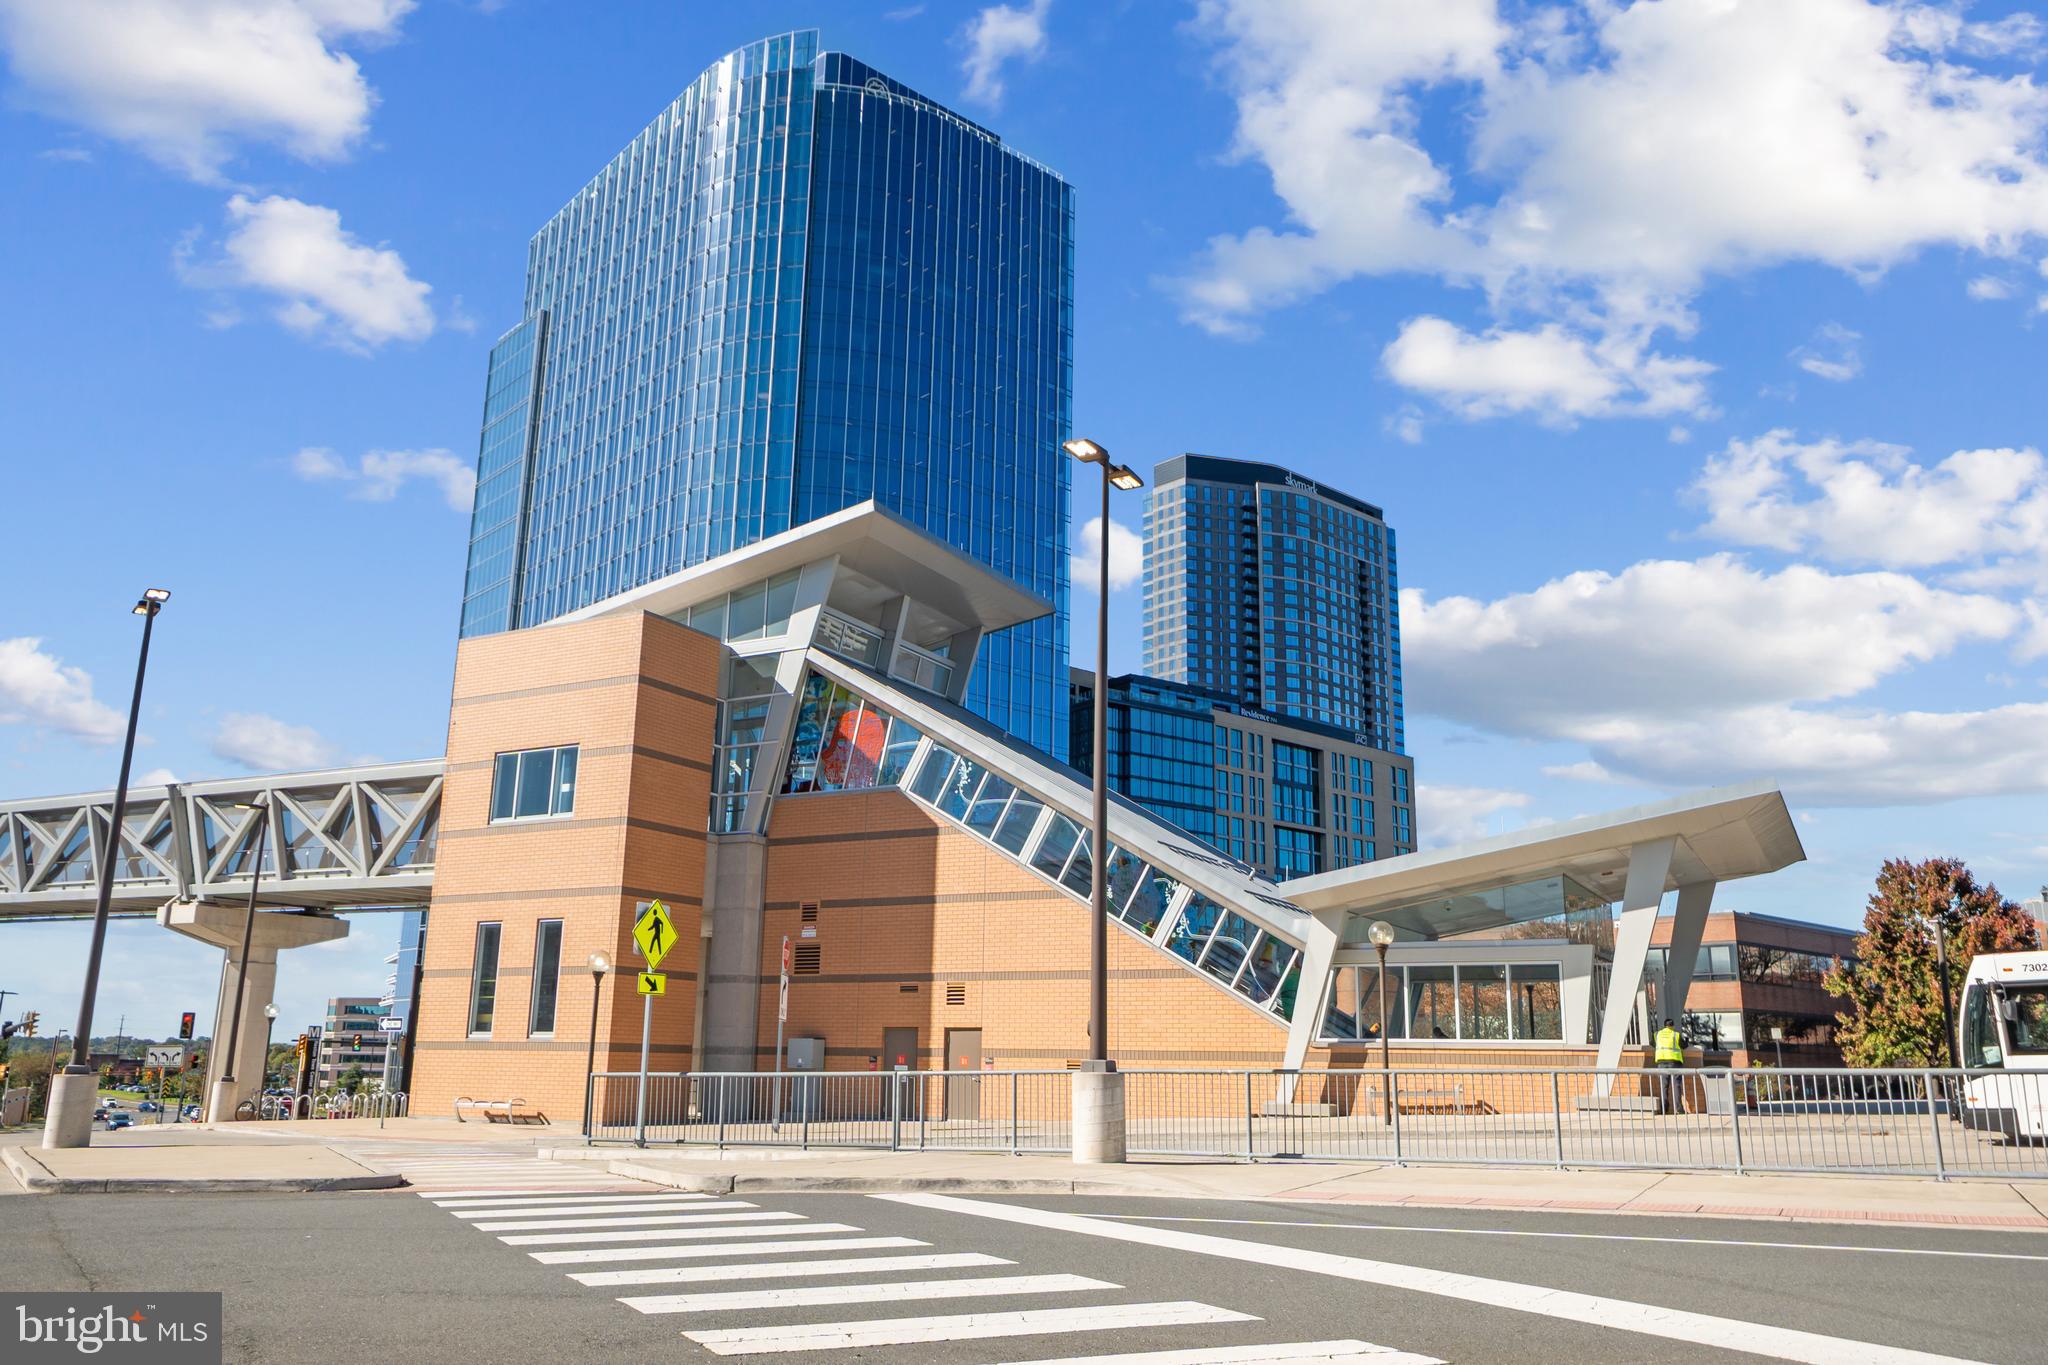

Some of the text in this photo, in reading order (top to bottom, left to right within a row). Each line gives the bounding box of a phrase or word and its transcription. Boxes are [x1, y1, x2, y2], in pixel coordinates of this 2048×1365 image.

[1285, 472, 1317, 494] skymark
[1241, 707, 1269, 722] Residence
[1355, 734, 1367, 746] AC
[2021, 963, 2048, 972] 7302
[308, 1026, 320, 1038] M
